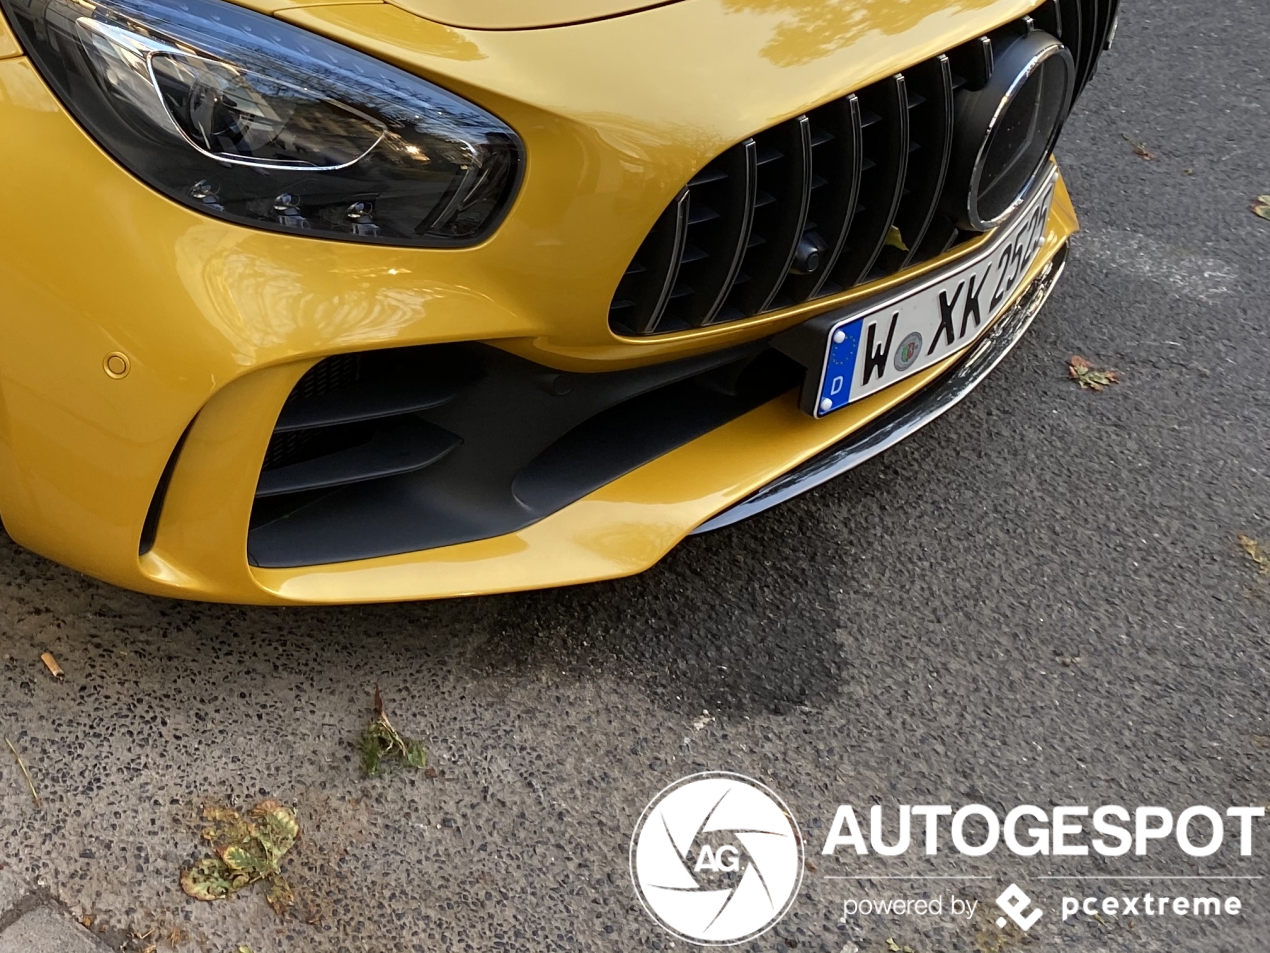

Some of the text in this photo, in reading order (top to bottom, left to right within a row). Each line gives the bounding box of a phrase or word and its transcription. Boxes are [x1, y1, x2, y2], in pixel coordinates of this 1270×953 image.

[861, 310, 900, 387] W
[926, 261, 993, 357] XK
[830, 375, 844, 396] D
